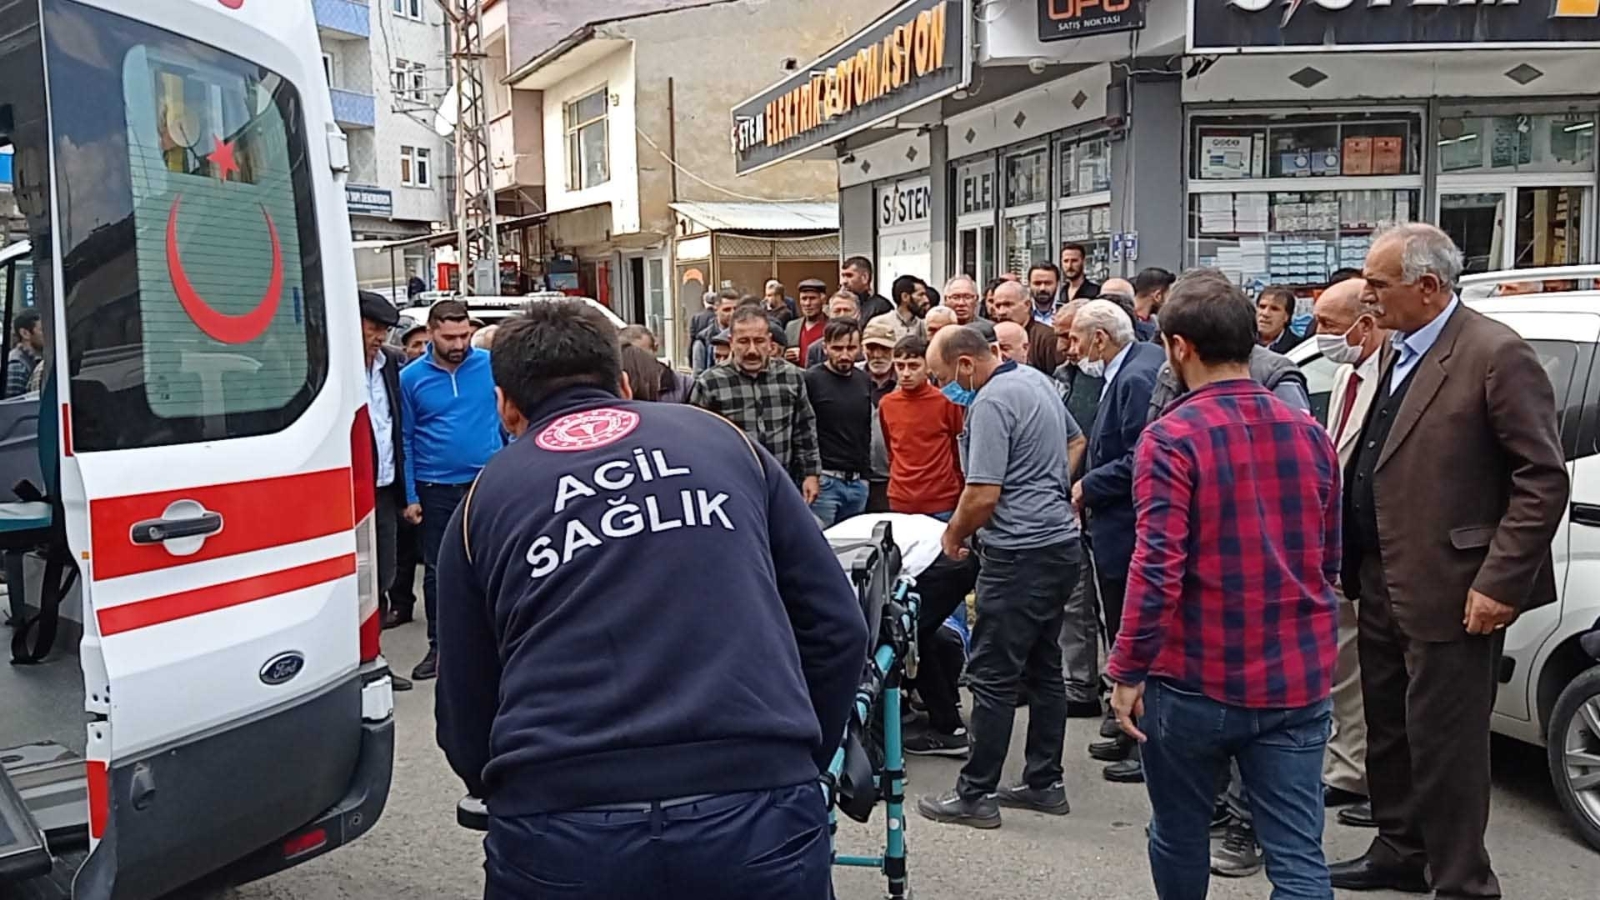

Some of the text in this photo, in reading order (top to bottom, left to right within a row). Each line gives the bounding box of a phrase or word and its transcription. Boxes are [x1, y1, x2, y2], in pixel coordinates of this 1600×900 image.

[1058, 20, 1081, 31] SATIŞ
[964, 172, 995, 213] ELE
[554, 447, 691, 514] ACİL
[526, 489, 735, 578] SAĞLIK
[273, 658, 298, 679] Ford
